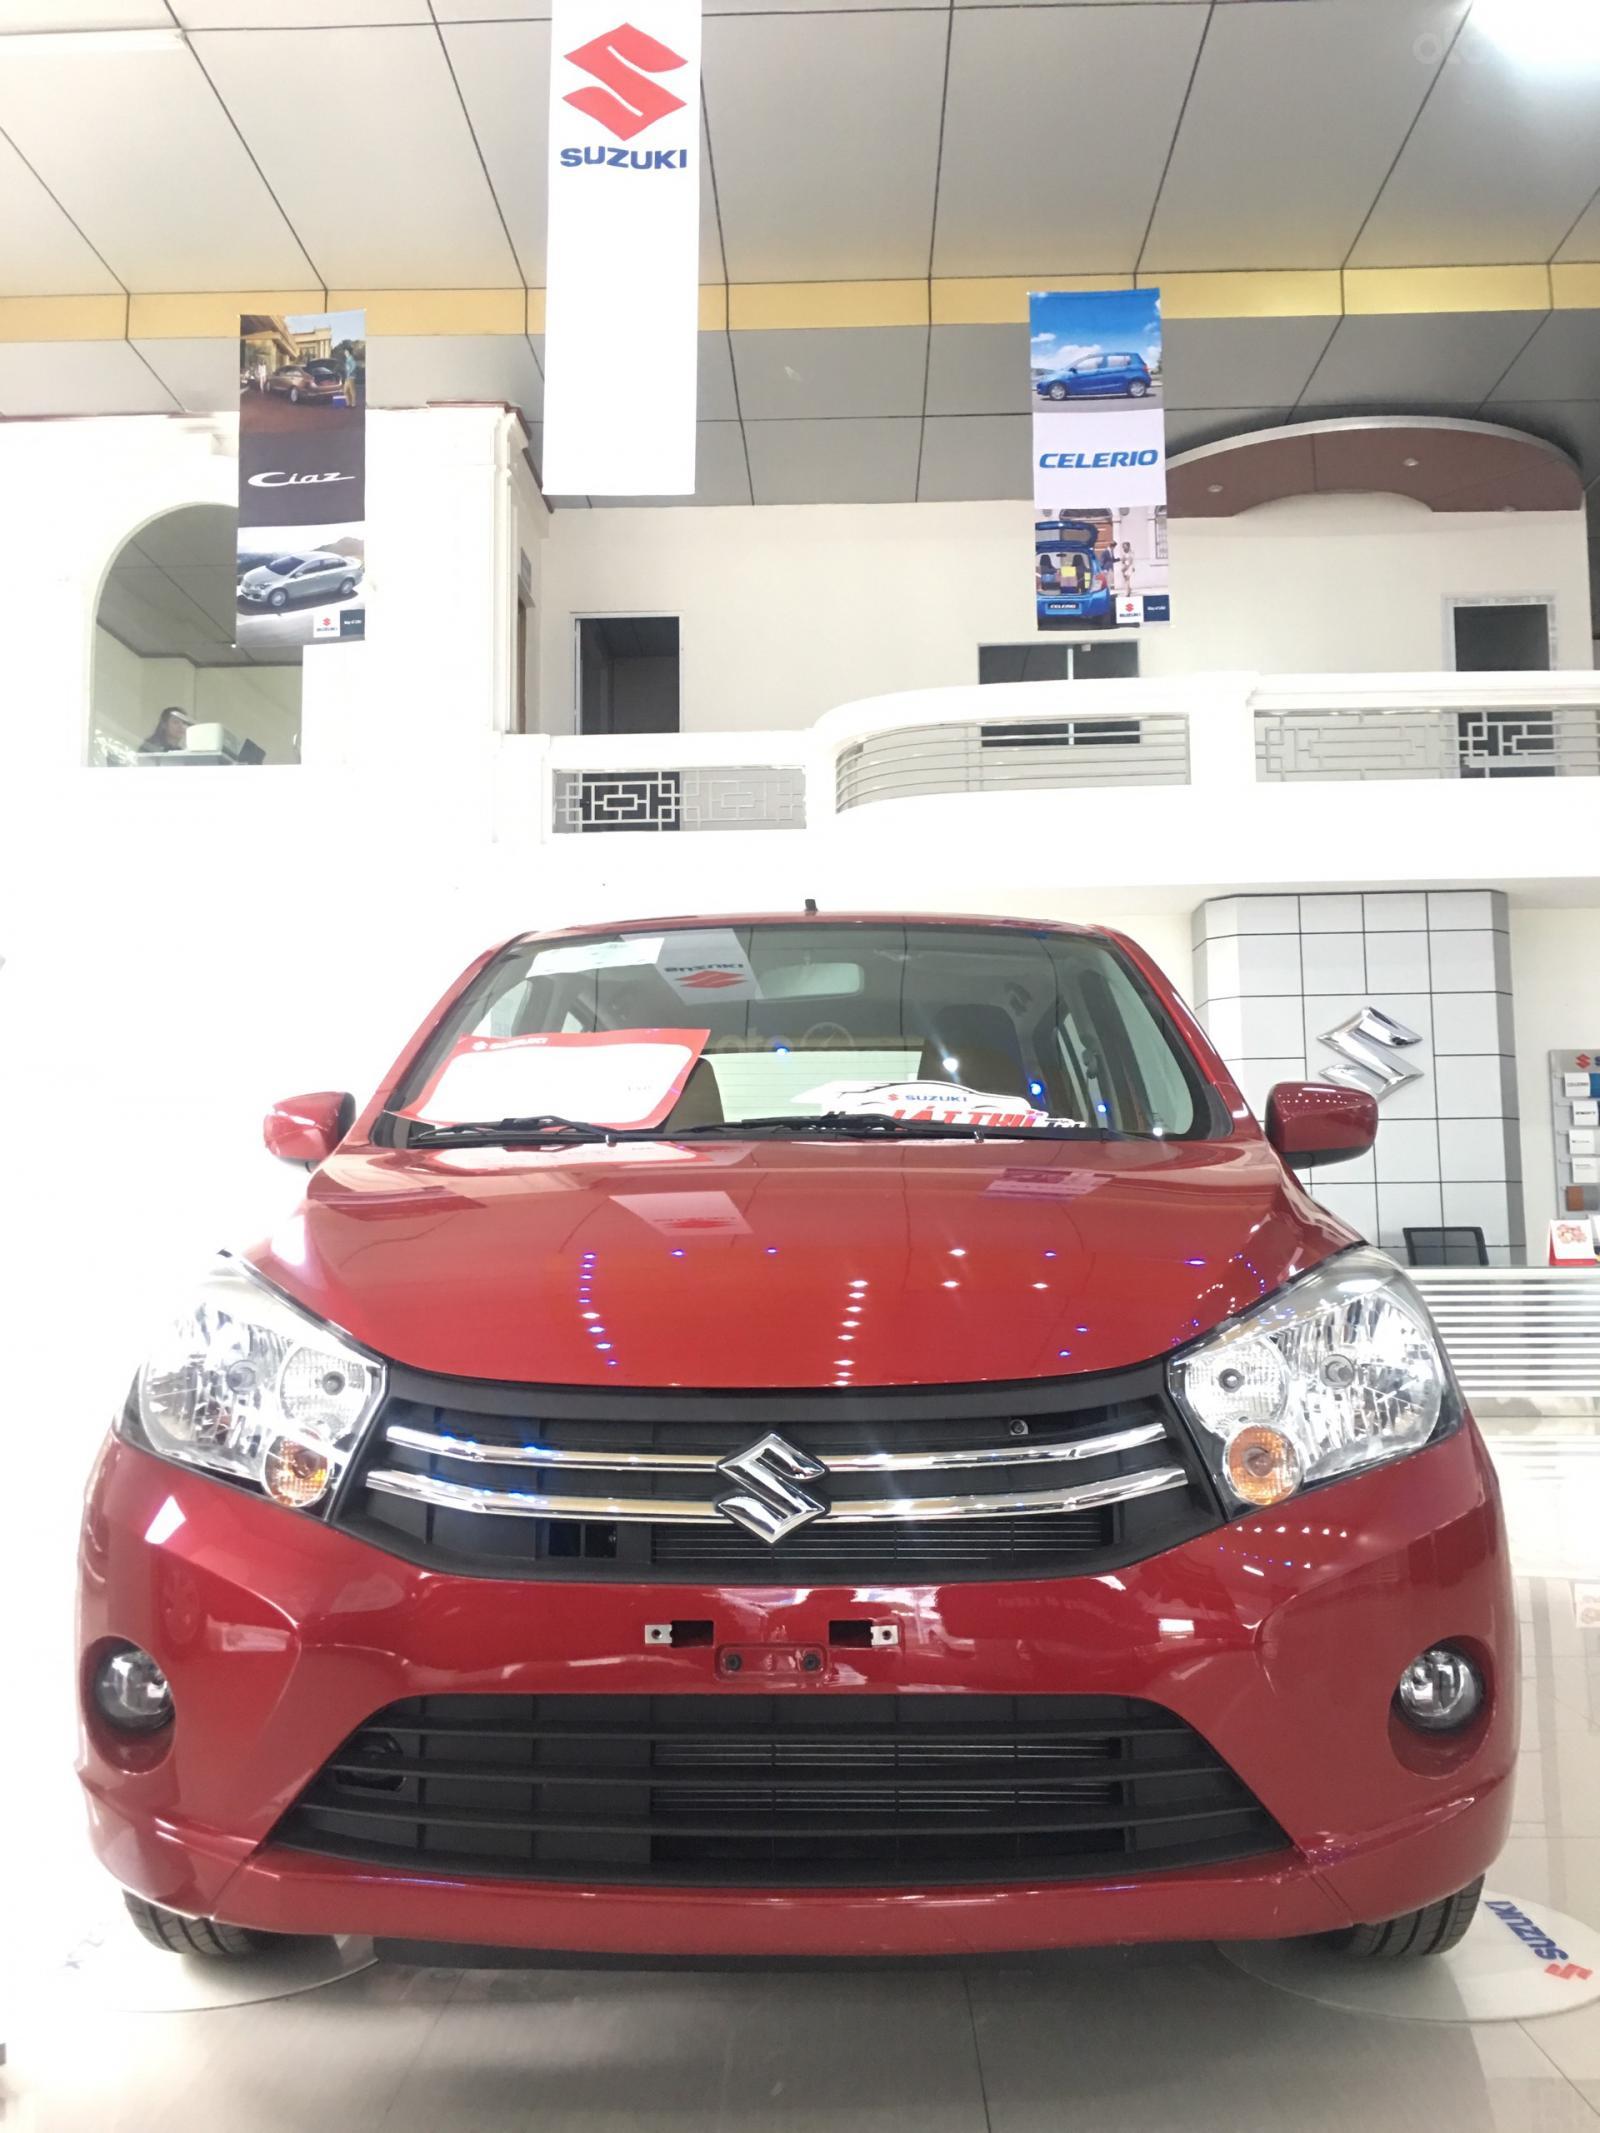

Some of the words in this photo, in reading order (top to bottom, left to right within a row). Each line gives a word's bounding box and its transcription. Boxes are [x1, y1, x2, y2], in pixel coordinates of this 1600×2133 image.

[560, 146, 687, 169] SUZUKI
[1039, 449, 1158, 468] CELERIO
[247, 471, 356, 487] Ciaz
[905, 1095, 968, 1103] SUZUKI
[1484, 1900, 1570, 1961] SUZUKI
